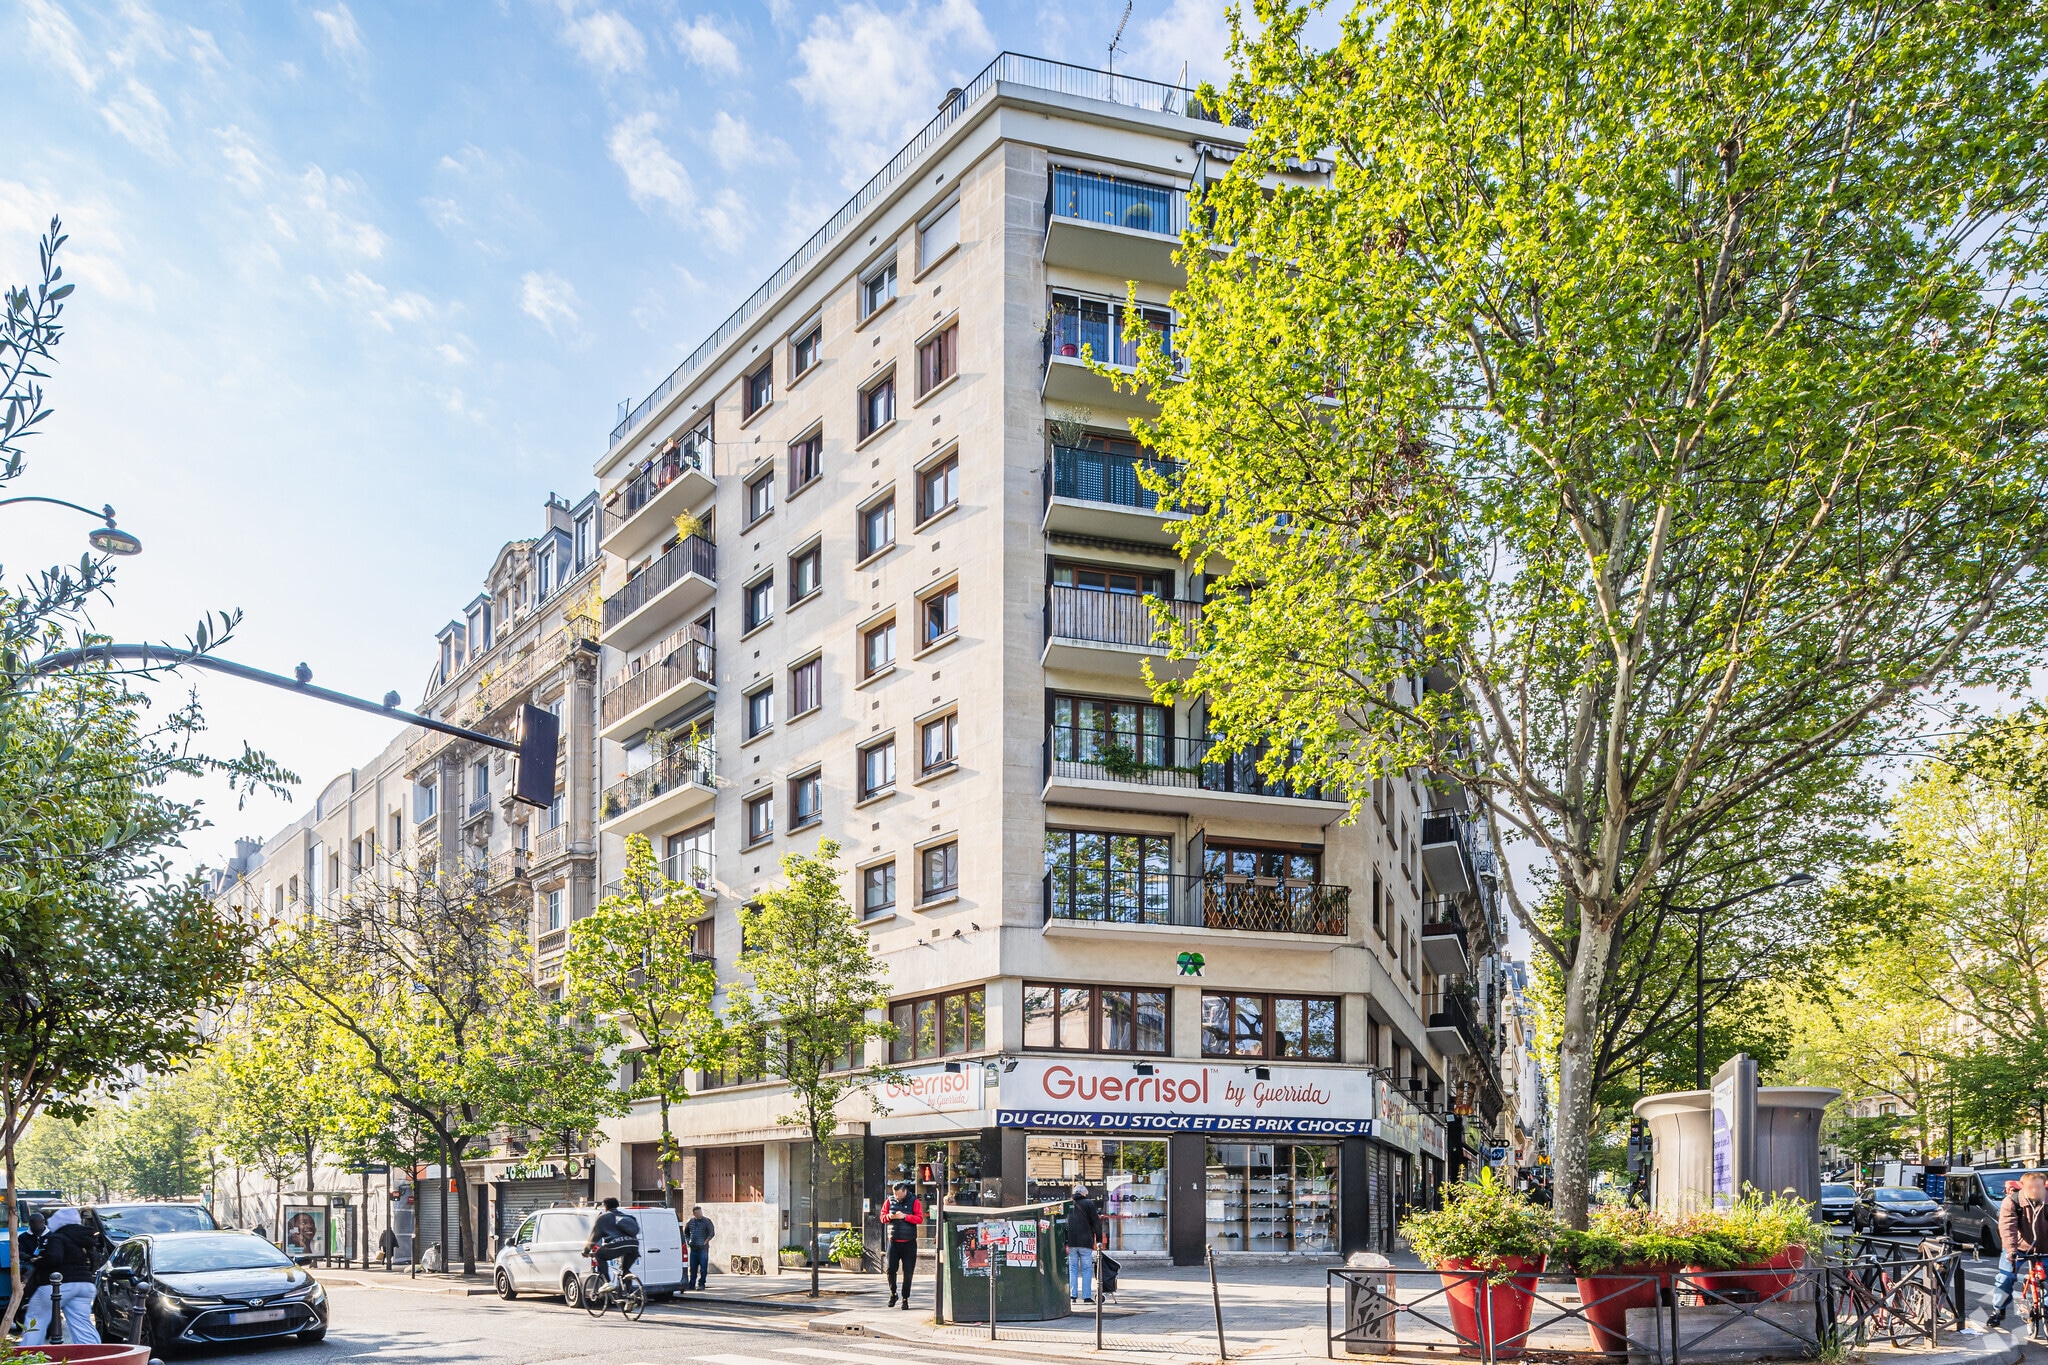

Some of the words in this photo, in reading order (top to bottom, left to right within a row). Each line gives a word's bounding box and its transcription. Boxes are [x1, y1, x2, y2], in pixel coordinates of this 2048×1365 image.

[886, 1064, 970, 1099] Guerrisol
[1042, 1065, 1208, 1104] Guerrisol
[1225, 1080, 1247, 1108] by
[1253, 1082, 1331, 1109] Guerrida
[999, 1112, 1029, 1125] DU
[1031, 1113, 1096, 1128] CHOIX,
[1099, 1115, 1129, 1127] DU
[1131, 1116, 1190, 1129] STOCK
[1193, 1118, 1216, 1129] ET
[1217, 1118, 1252, 1130] DES
[1254, 1119, 1295, 1131] PRIX
[1297, 1120, 1356, 1133] CHOCS
[1358, 1121, 1371, 1133] !!
[1537, 1154, 1551, 1165] M
